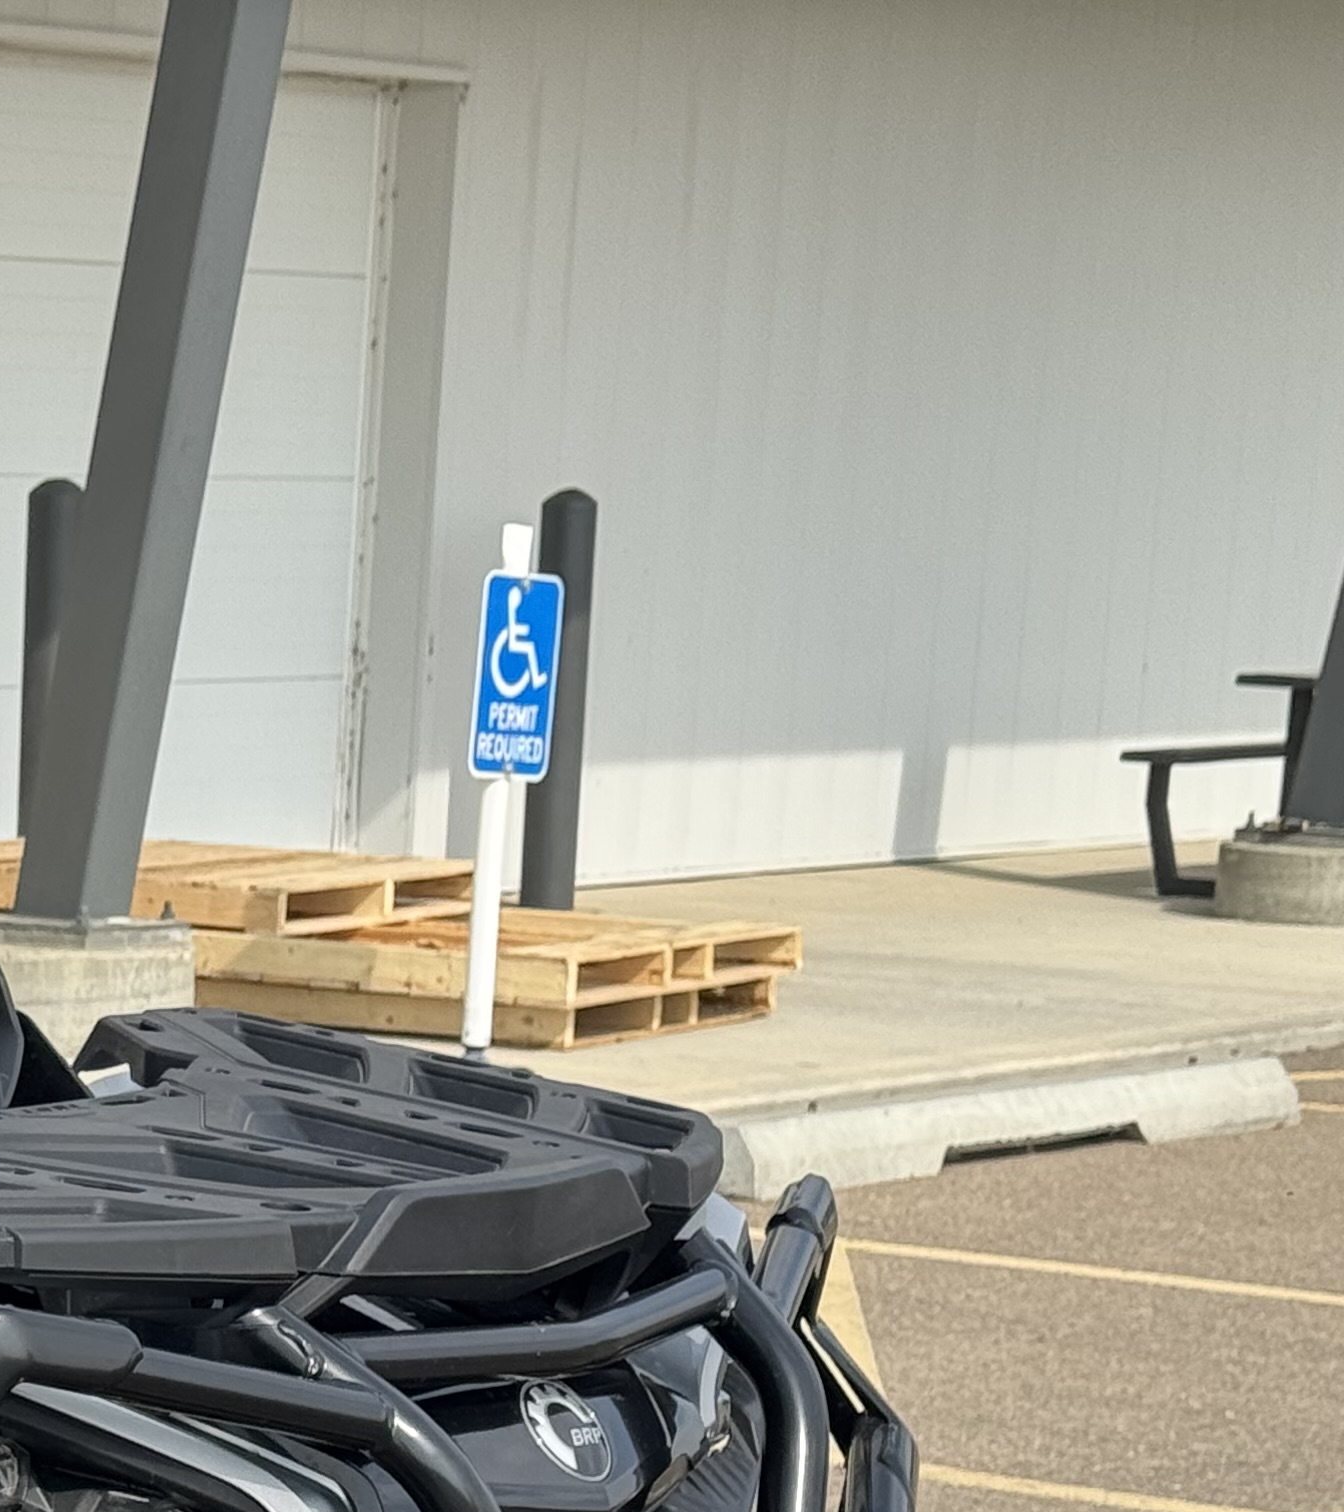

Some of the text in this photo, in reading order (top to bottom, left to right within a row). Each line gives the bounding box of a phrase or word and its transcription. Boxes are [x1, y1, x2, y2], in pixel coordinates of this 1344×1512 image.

[488, 702, 539, 732] PERMIT
[476, 732, 543, 764] REQUIRED
[570, 1426, 601, 1447] BRP
